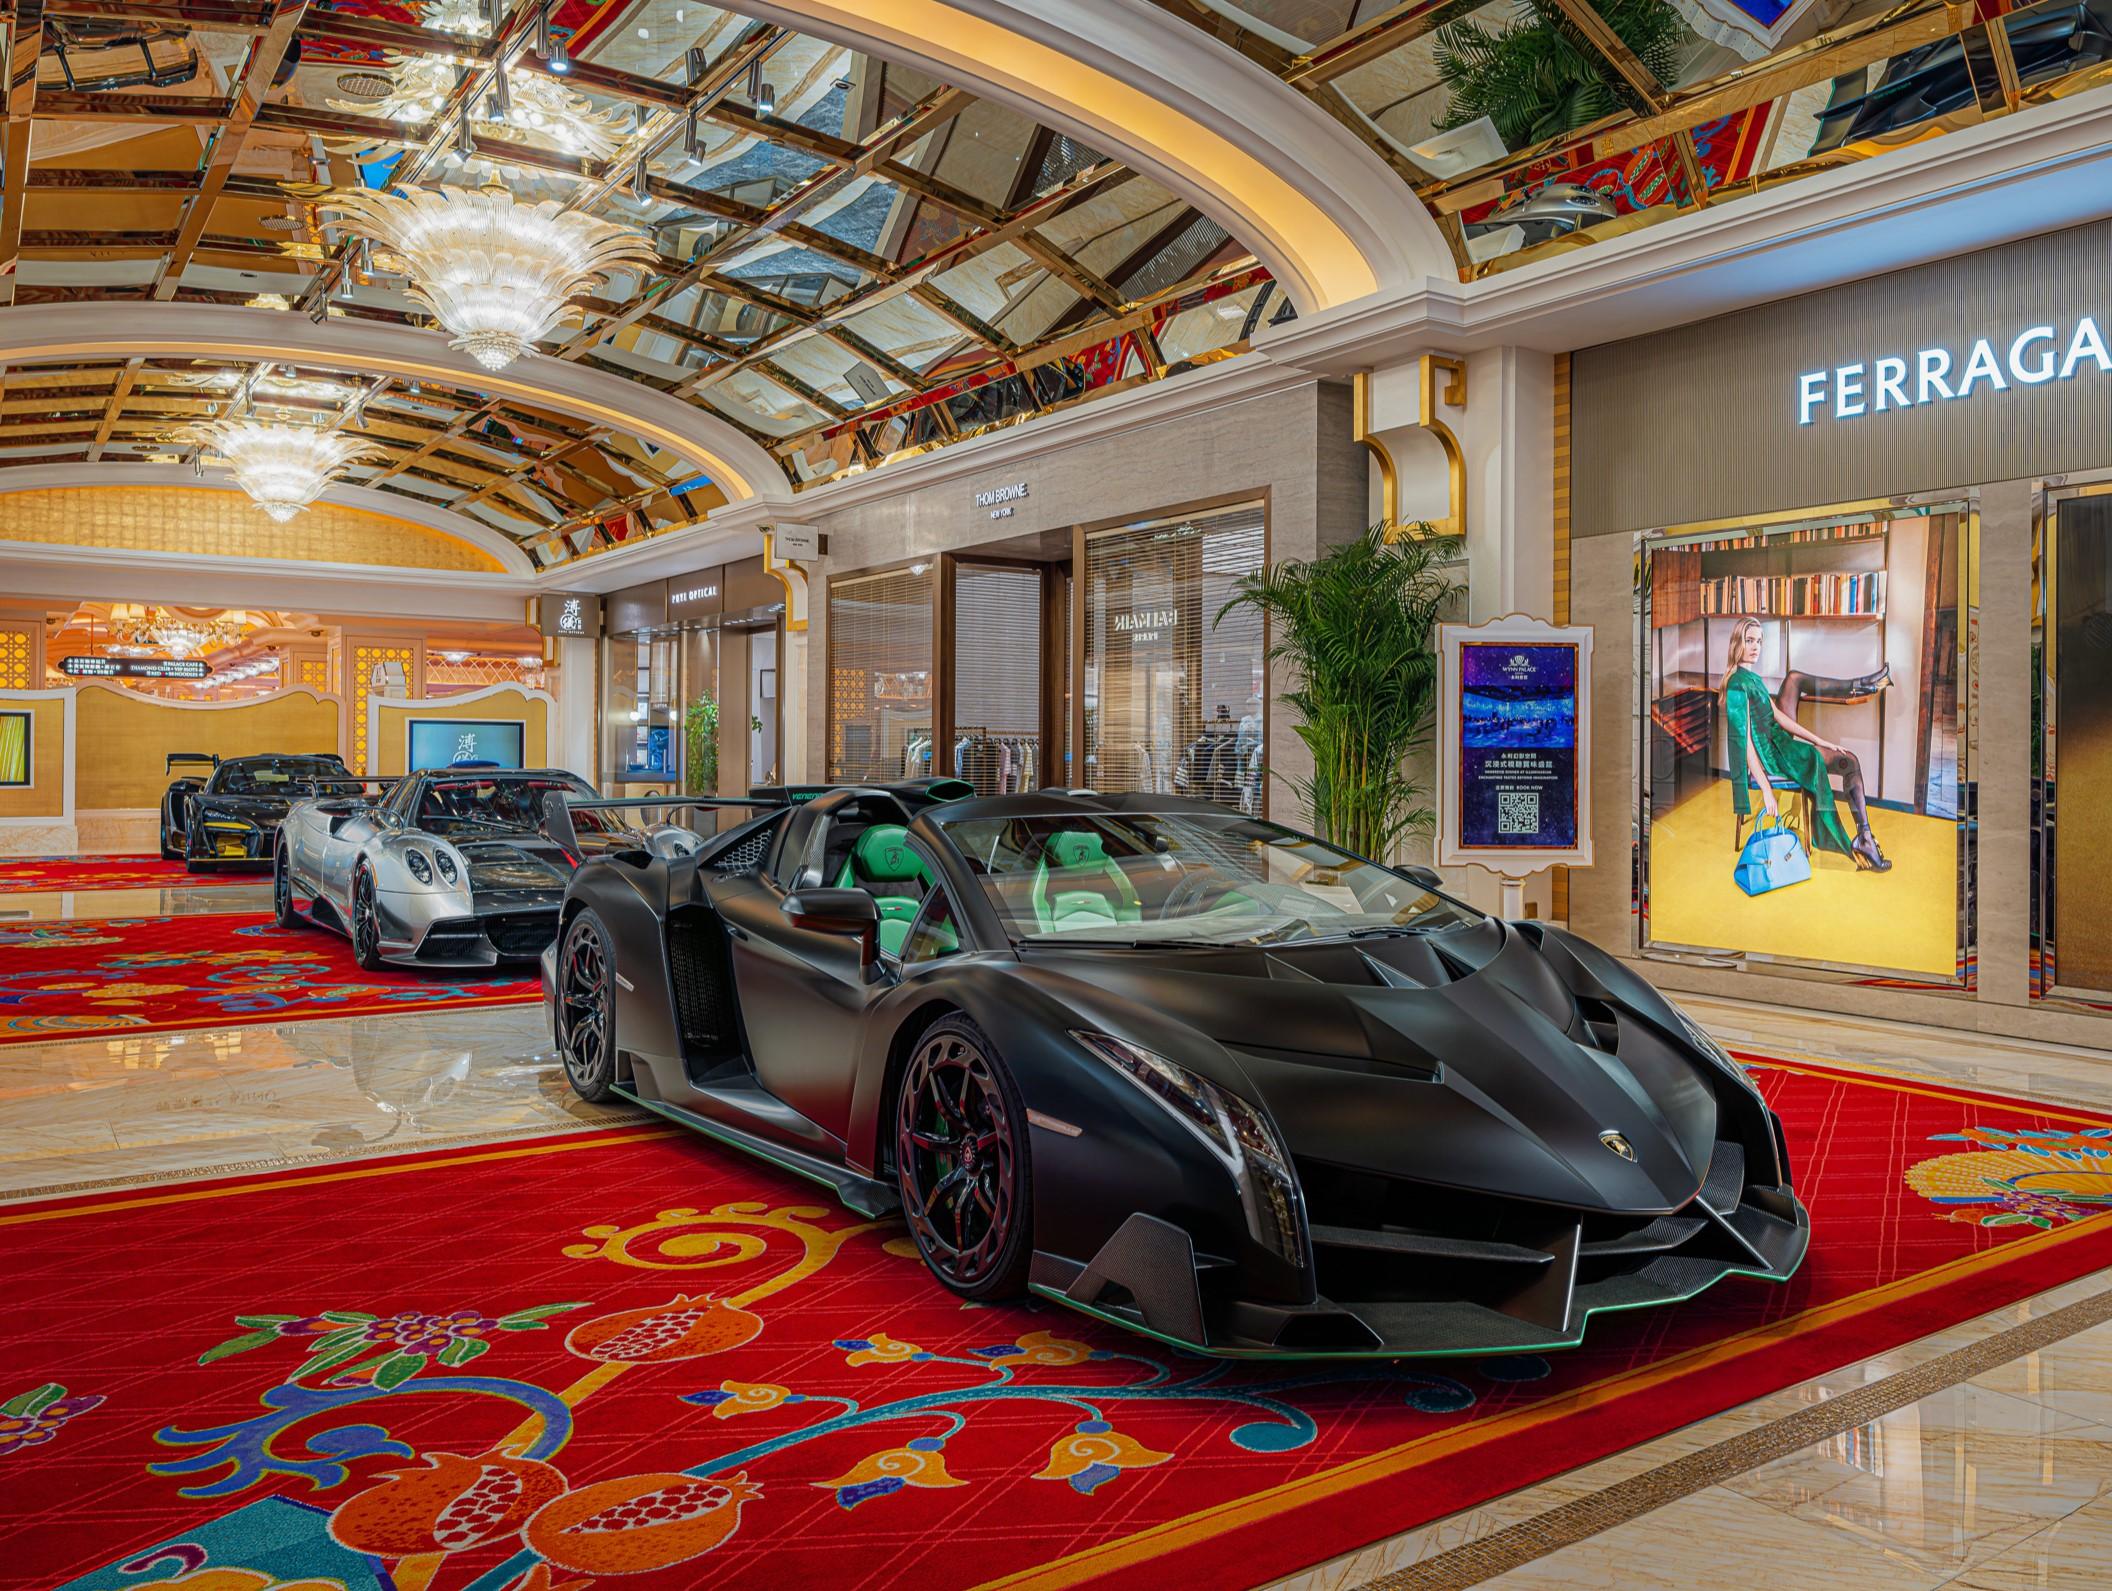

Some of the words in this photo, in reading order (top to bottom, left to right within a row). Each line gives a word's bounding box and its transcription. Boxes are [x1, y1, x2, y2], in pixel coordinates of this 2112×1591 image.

[1798, 317, 2112, 425] FERRAGA
[975, 491, 995, 508] THOM
[688, 585, 718, 601] OPTICAL
